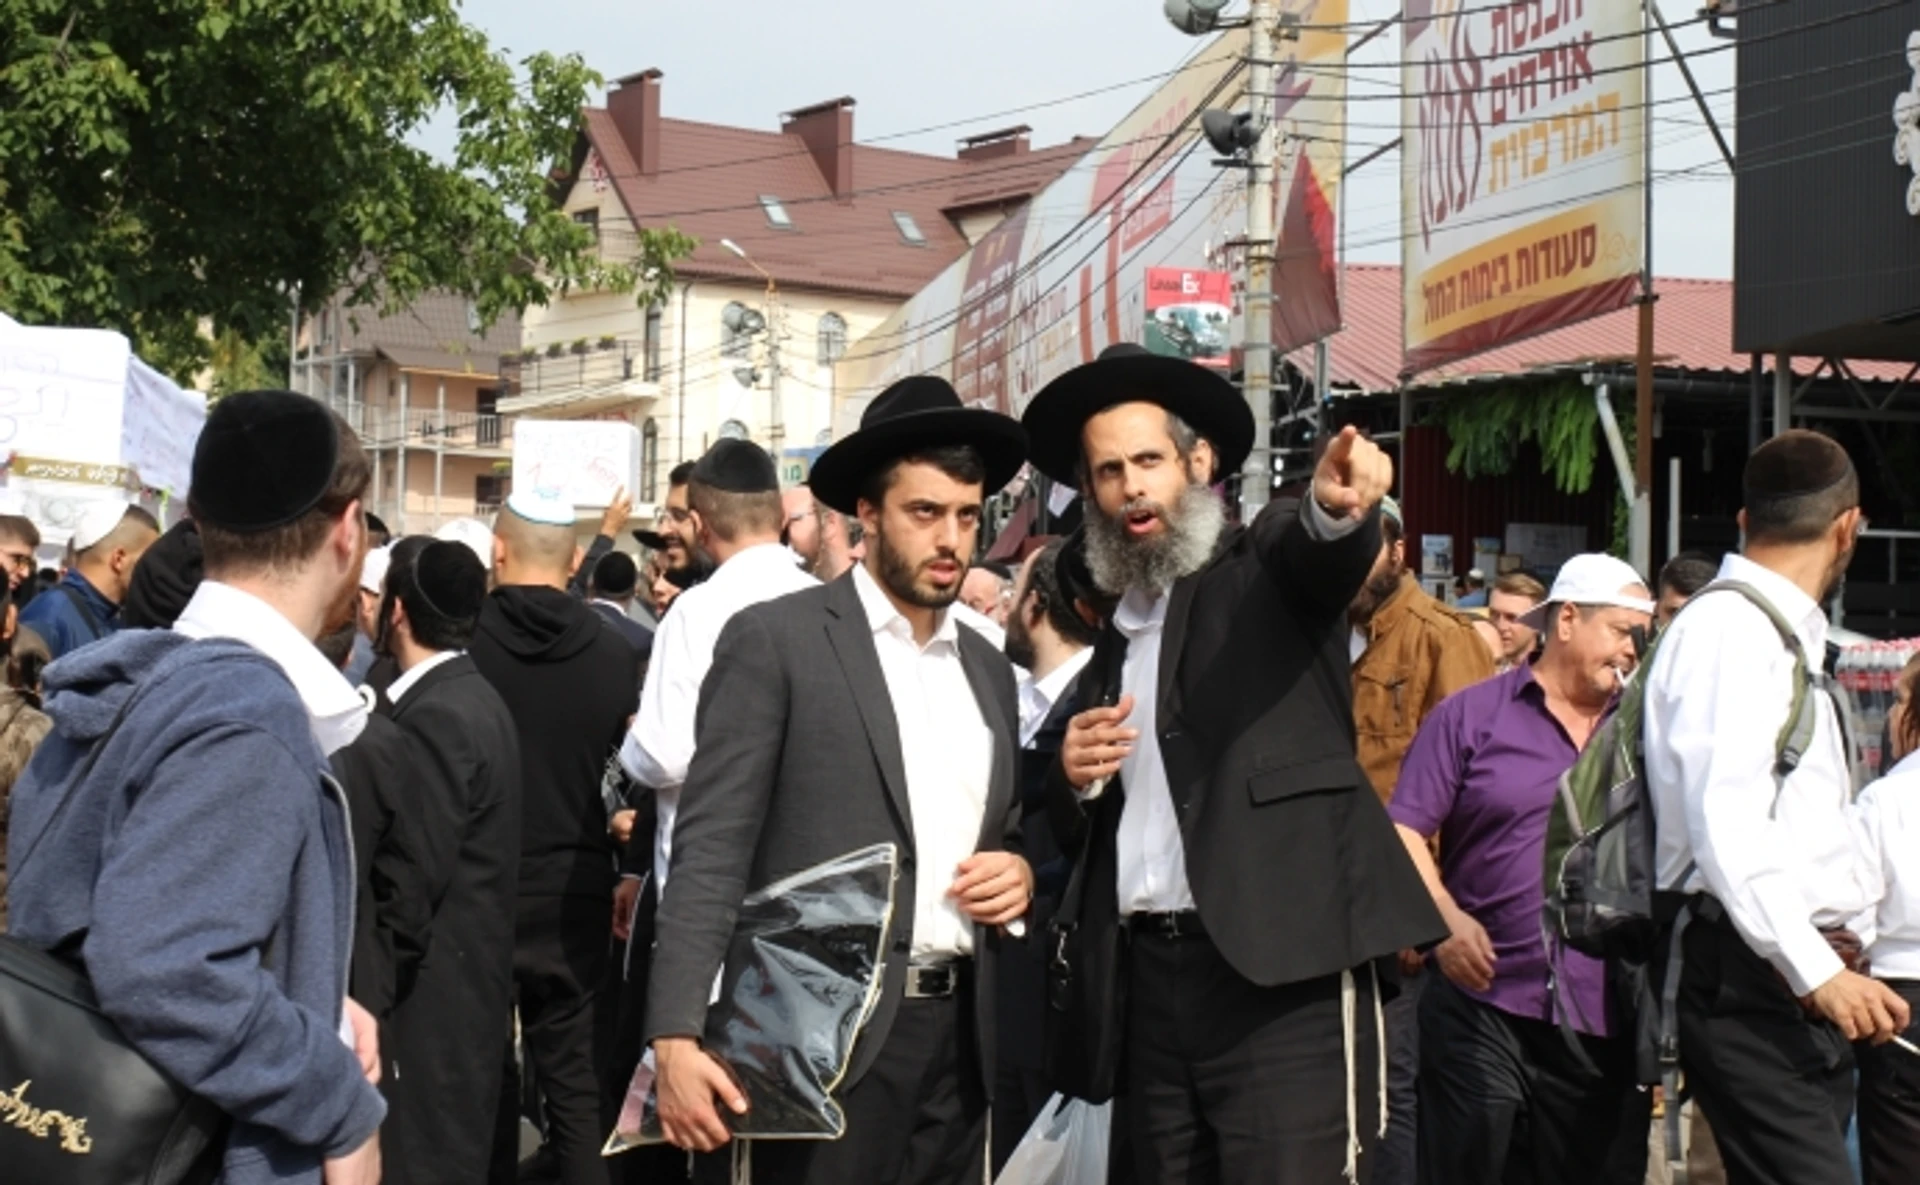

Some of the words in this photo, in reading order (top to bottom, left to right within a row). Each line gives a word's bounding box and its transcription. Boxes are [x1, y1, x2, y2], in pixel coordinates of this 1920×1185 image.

[1489, 30, 1594, 127] אורחים
[1488, 91, 1620, 194] המרכזית
[1515, 223, 1597, 290] סעודות
